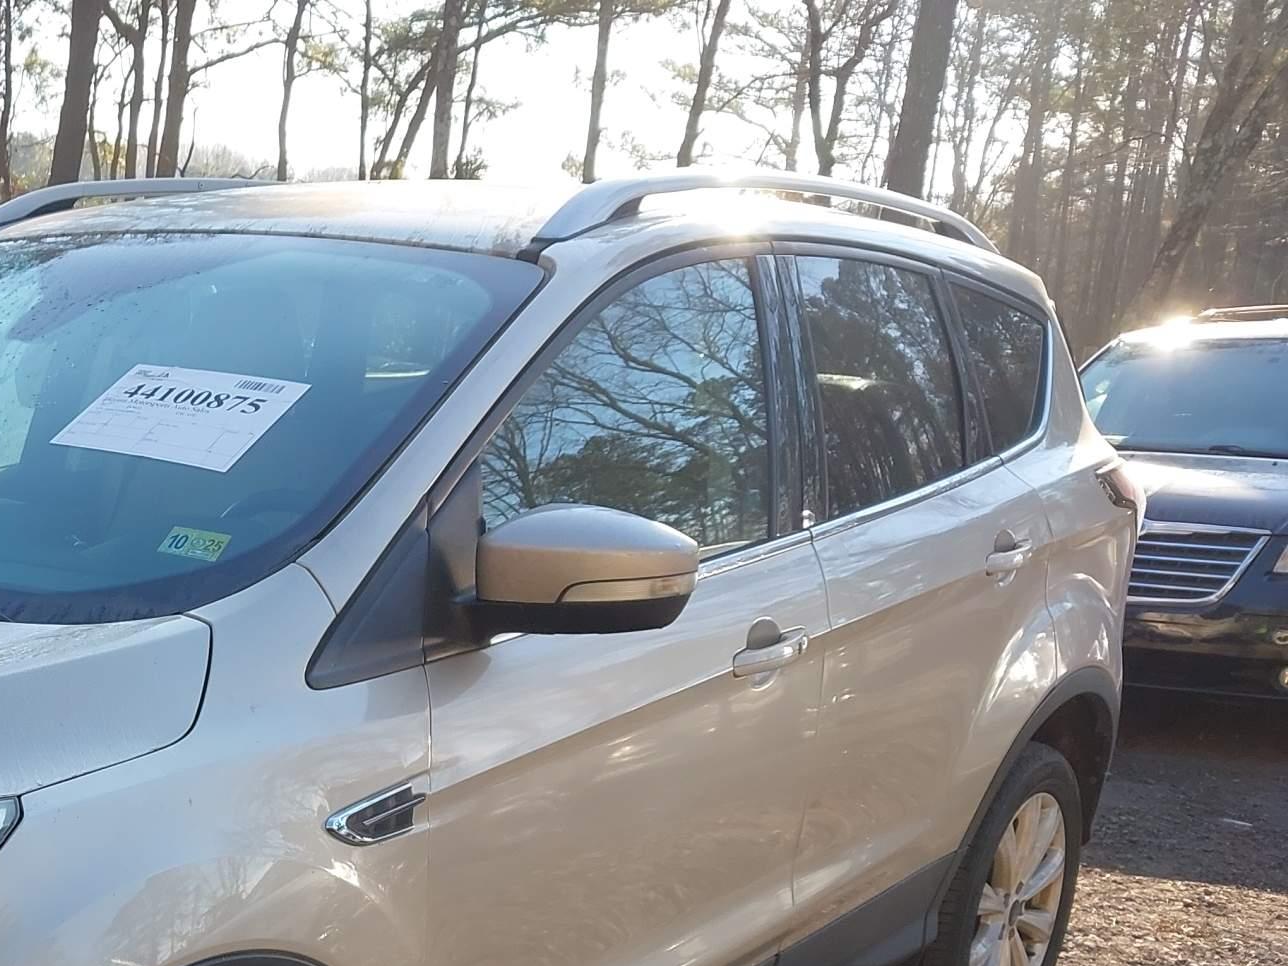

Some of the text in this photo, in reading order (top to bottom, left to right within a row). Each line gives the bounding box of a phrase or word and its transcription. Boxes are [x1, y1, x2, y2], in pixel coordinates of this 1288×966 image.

[123, 383, 268, 415] 44100875
[168, 533, 224, 553] 10 25
